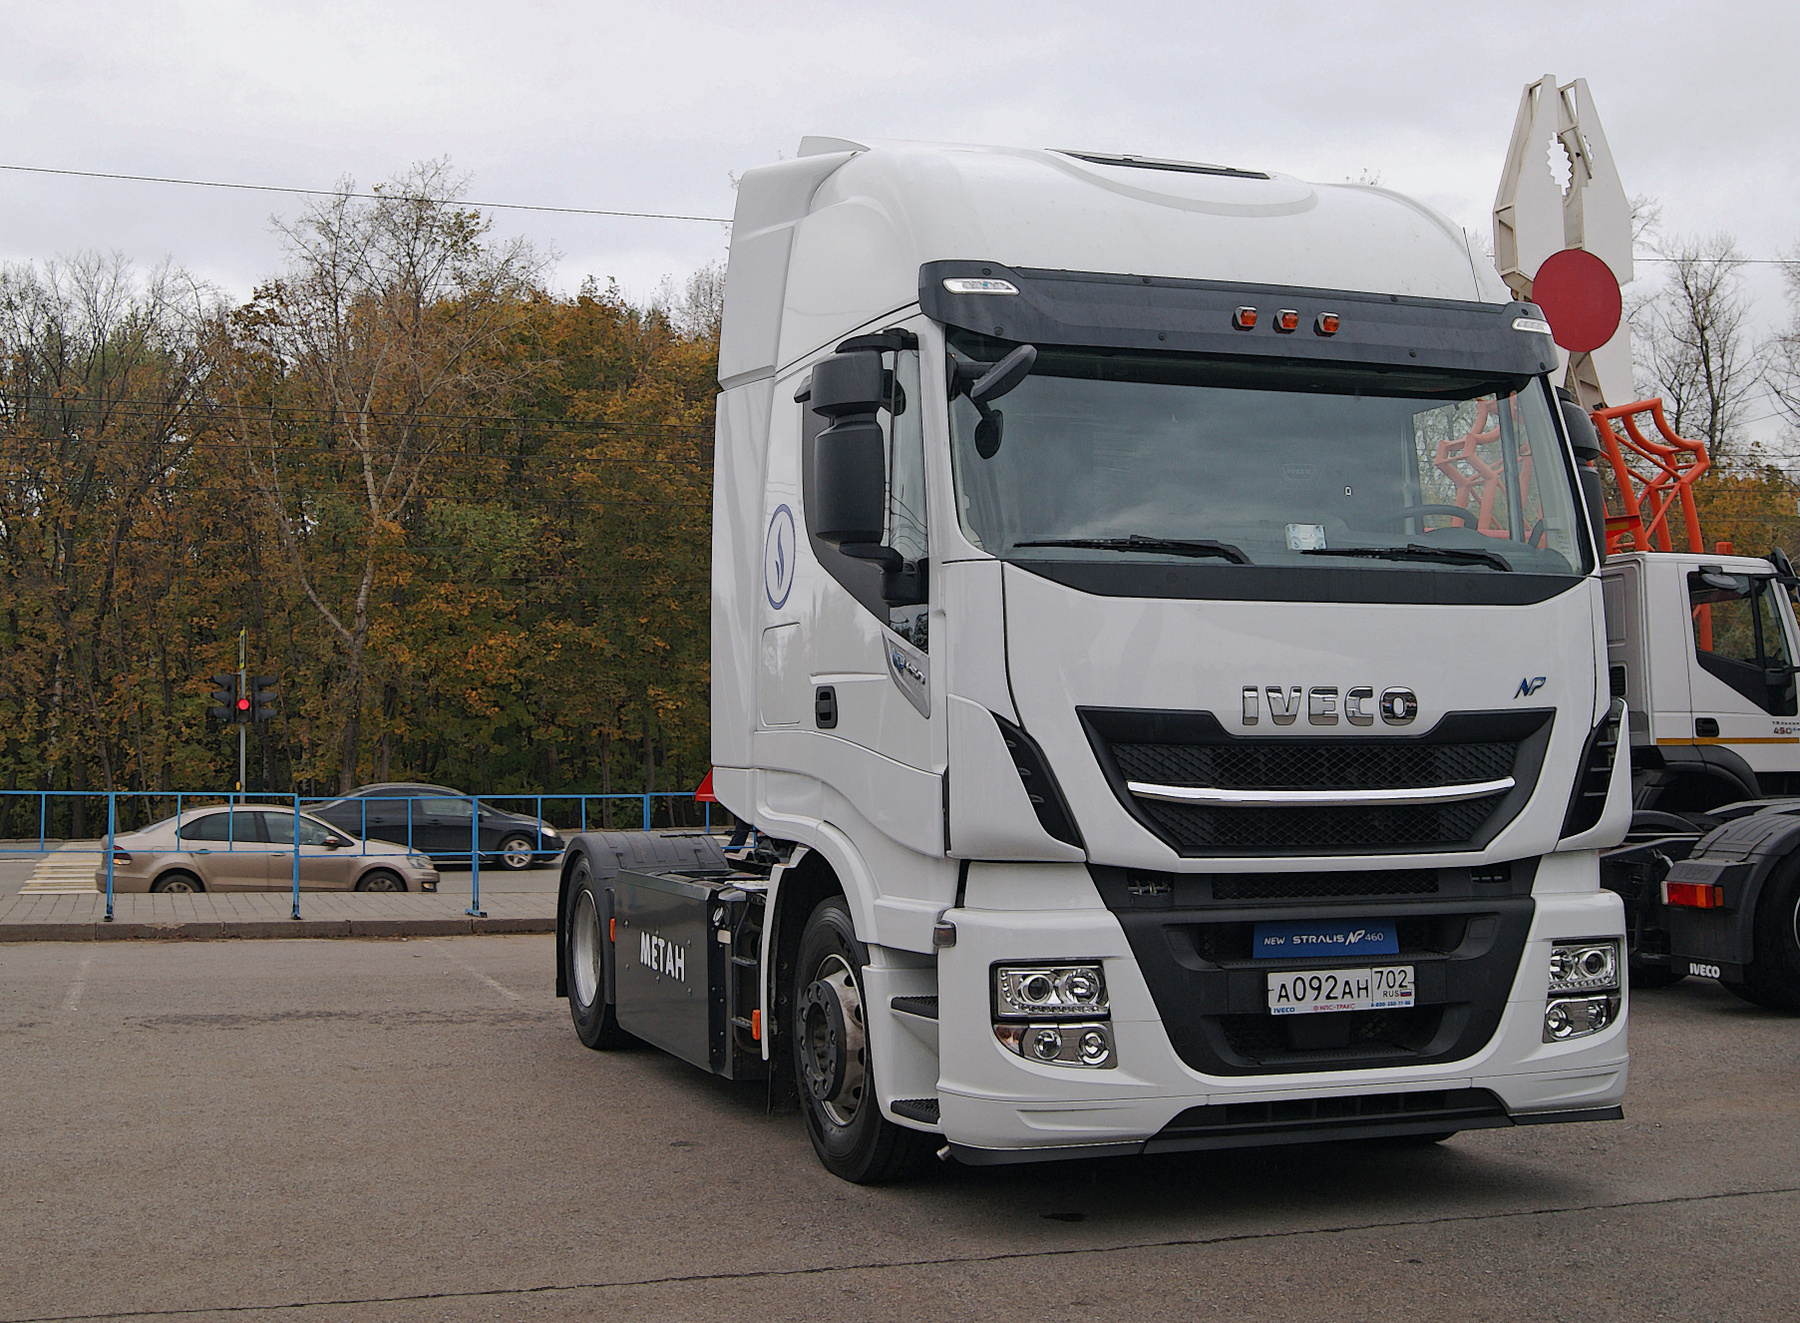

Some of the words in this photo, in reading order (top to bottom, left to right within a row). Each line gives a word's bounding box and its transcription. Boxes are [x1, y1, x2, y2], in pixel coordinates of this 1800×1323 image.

[1242, 686, 1418, 726] IVECO
[1263, 936, 1286, 946] NEW
[1292, 934, 1344, 945] STRALIS
[1365, 932, 1384, 942] 460
[640, 930, 685, 983] МЕТАН
[1689, 962, 1720, 978] IVECO
[1277, 975, 1369, 1003] А092АН
[1374, 969, 1408, 990] 702
[1382, 990, 1400, 998] RUS
